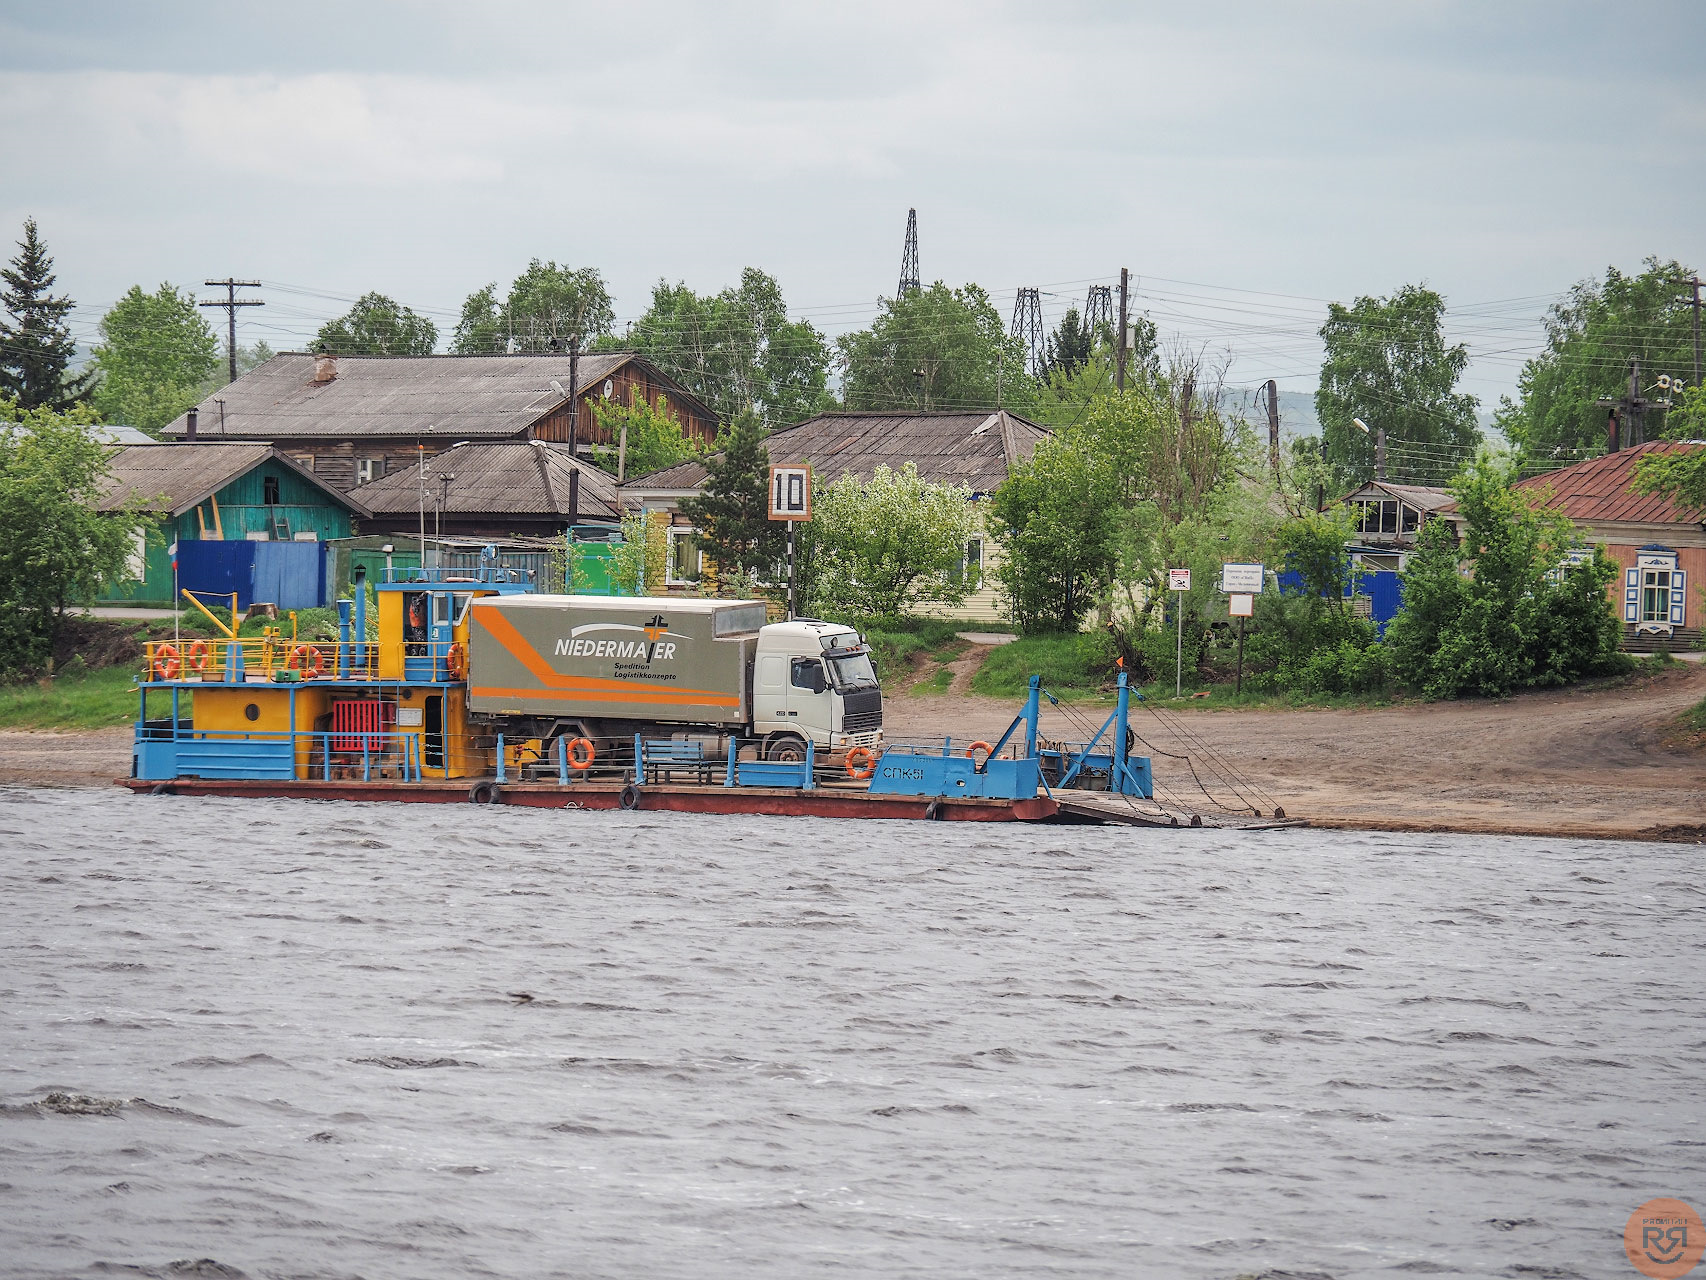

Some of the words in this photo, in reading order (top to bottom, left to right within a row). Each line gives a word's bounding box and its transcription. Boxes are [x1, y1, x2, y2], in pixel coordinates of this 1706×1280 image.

[775, 473, 803, 510] 10
[614, 662, 650, 671] Spedition
[614, 671, 677, 681] Logistikkonzepte
